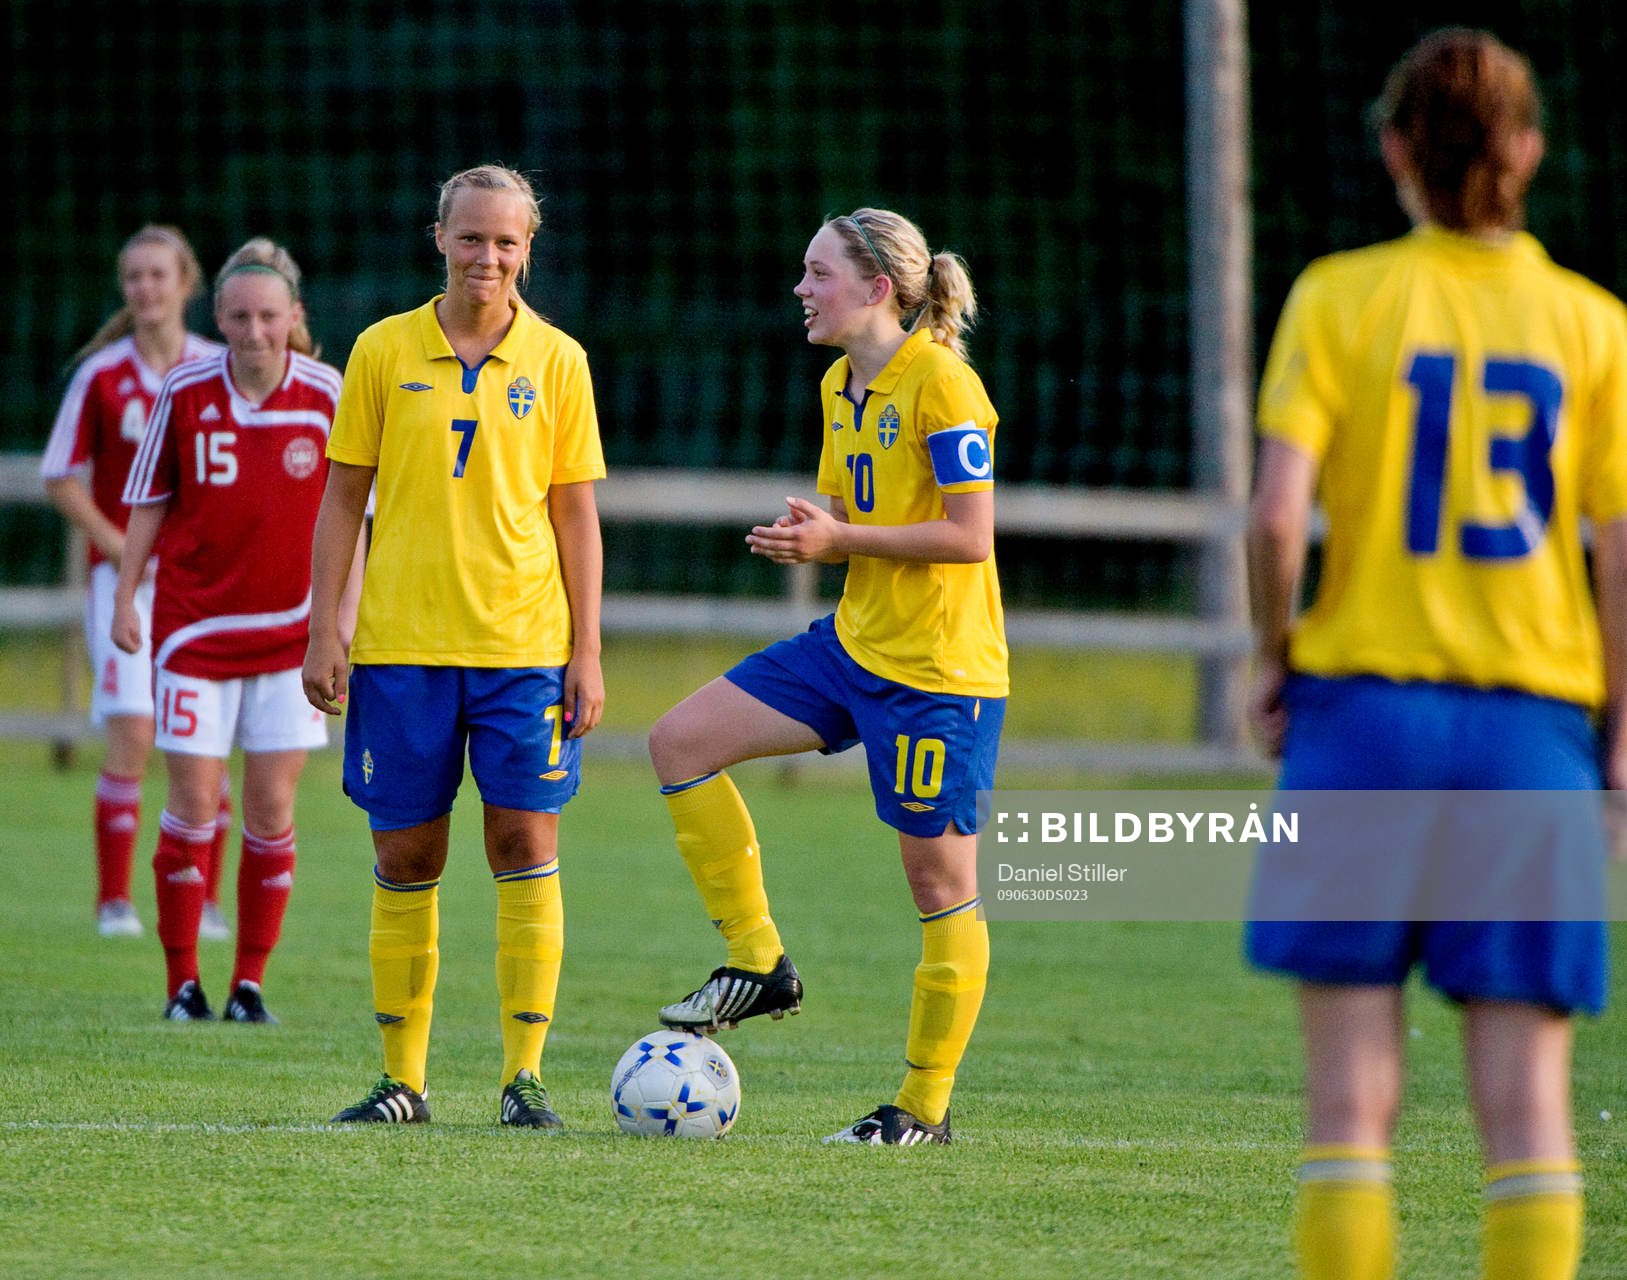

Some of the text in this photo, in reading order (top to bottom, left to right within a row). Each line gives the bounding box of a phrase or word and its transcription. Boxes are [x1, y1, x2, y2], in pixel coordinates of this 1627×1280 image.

[196, 432, 238, 485] 15
[451, 419, 478, 478] 7
[958, 433, 990, 477] C
[1407, 354, 1563, 559] 13
[846, 453, 875, 513] 10
[163, 688, 198, 737] 15
[894, 734, 946, 798] 10
